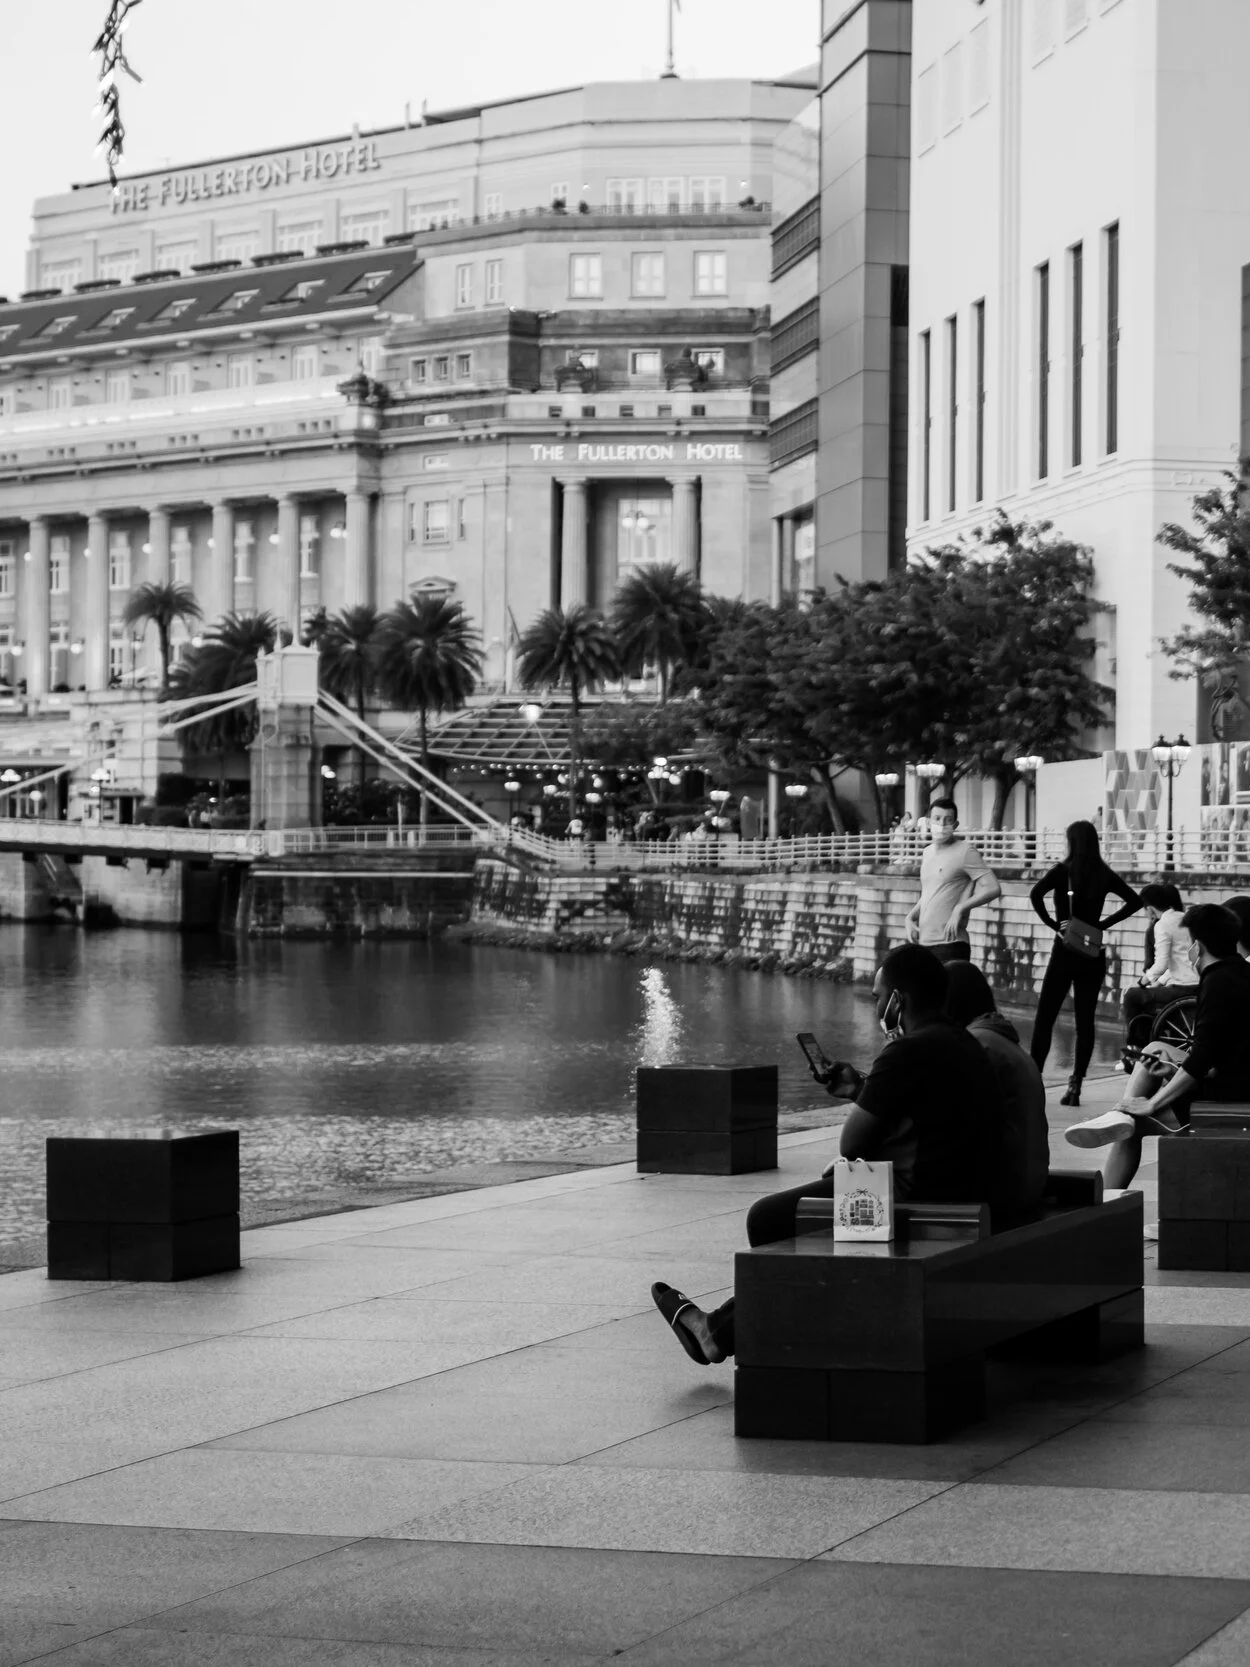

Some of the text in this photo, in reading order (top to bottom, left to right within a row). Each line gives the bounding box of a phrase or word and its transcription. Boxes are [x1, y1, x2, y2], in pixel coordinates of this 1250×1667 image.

[161, 157, 291, 207] FULLERTON
[299, 141, 381, 182] HOTEL
[530, 442, 744, 461] THE FULLERTON HOTEL
